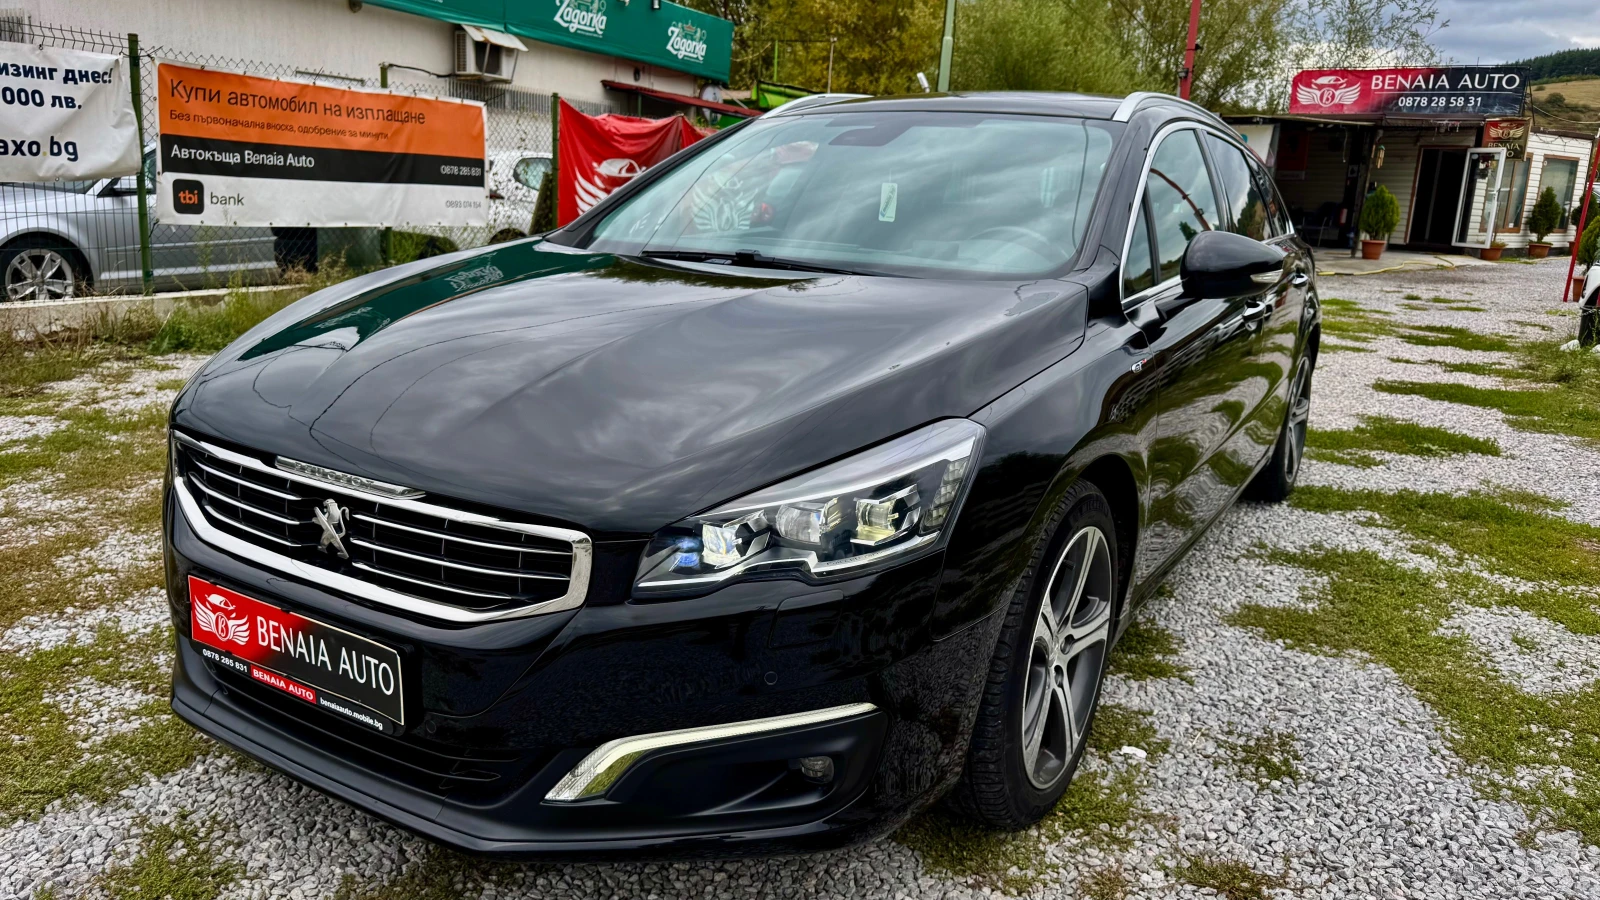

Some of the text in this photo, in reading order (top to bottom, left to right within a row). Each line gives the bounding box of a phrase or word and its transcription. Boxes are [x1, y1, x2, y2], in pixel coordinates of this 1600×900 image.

[554, 0, 608, 34] Zagorka
[666, 26, 707, 61] Zagorka
[63, 68, 113, 85] днес!
[1371, 74, 1520, 90] BENAIA AUTO
[51, 96, 82, 110] лв.
[170, 78, 426, 124] Купи автомобил на изплащане
[1398, 97, 1481, 107] 0878 28 58 31
[170, 109, 191, 122] Без
[193, 114, 265, 129] първоначална
[267, 123, 296, 134] вноска,
[298, 125, 346, 137] одобрение
[359, 131, 389, 140] минути
[170, 144, 315, 168] Автокъща Benaia Auto
[440, 165, 459, 175] 0878
[178, 190, 244, 206] tbi bank
[202, 648, 248, 672] 0878 285 831
[257, 616, 394, 696] BENAIA AUTO
[253, 668, 314, 700] BENAIA AUTO
[320, 697, 383, 731] benaiaauto.mobile.bg
